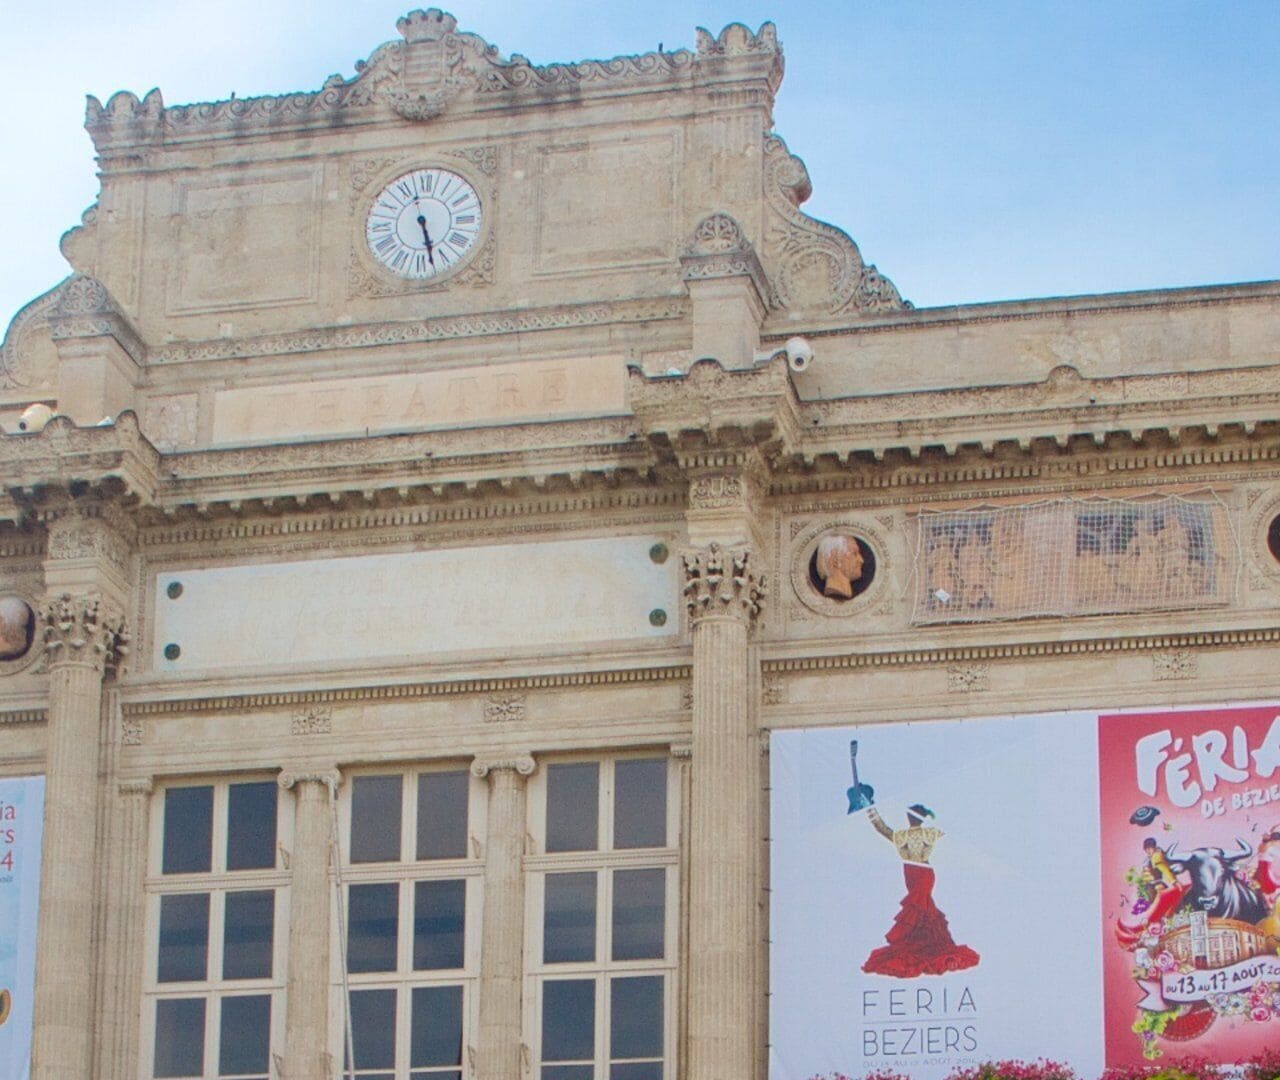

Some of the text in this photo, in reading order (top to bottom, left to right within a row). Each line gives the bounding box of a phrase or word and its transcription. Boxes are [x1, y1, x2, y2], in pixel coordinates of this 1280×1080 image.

[1201, 797, 1226, 819] DE
[1177, 976, 1196, 994] 13
[1210, 971, 1228, 990] 17
[863, 987, 977, 1016] FERIA
[863, 1026, 977, 1057] BEZIERS
